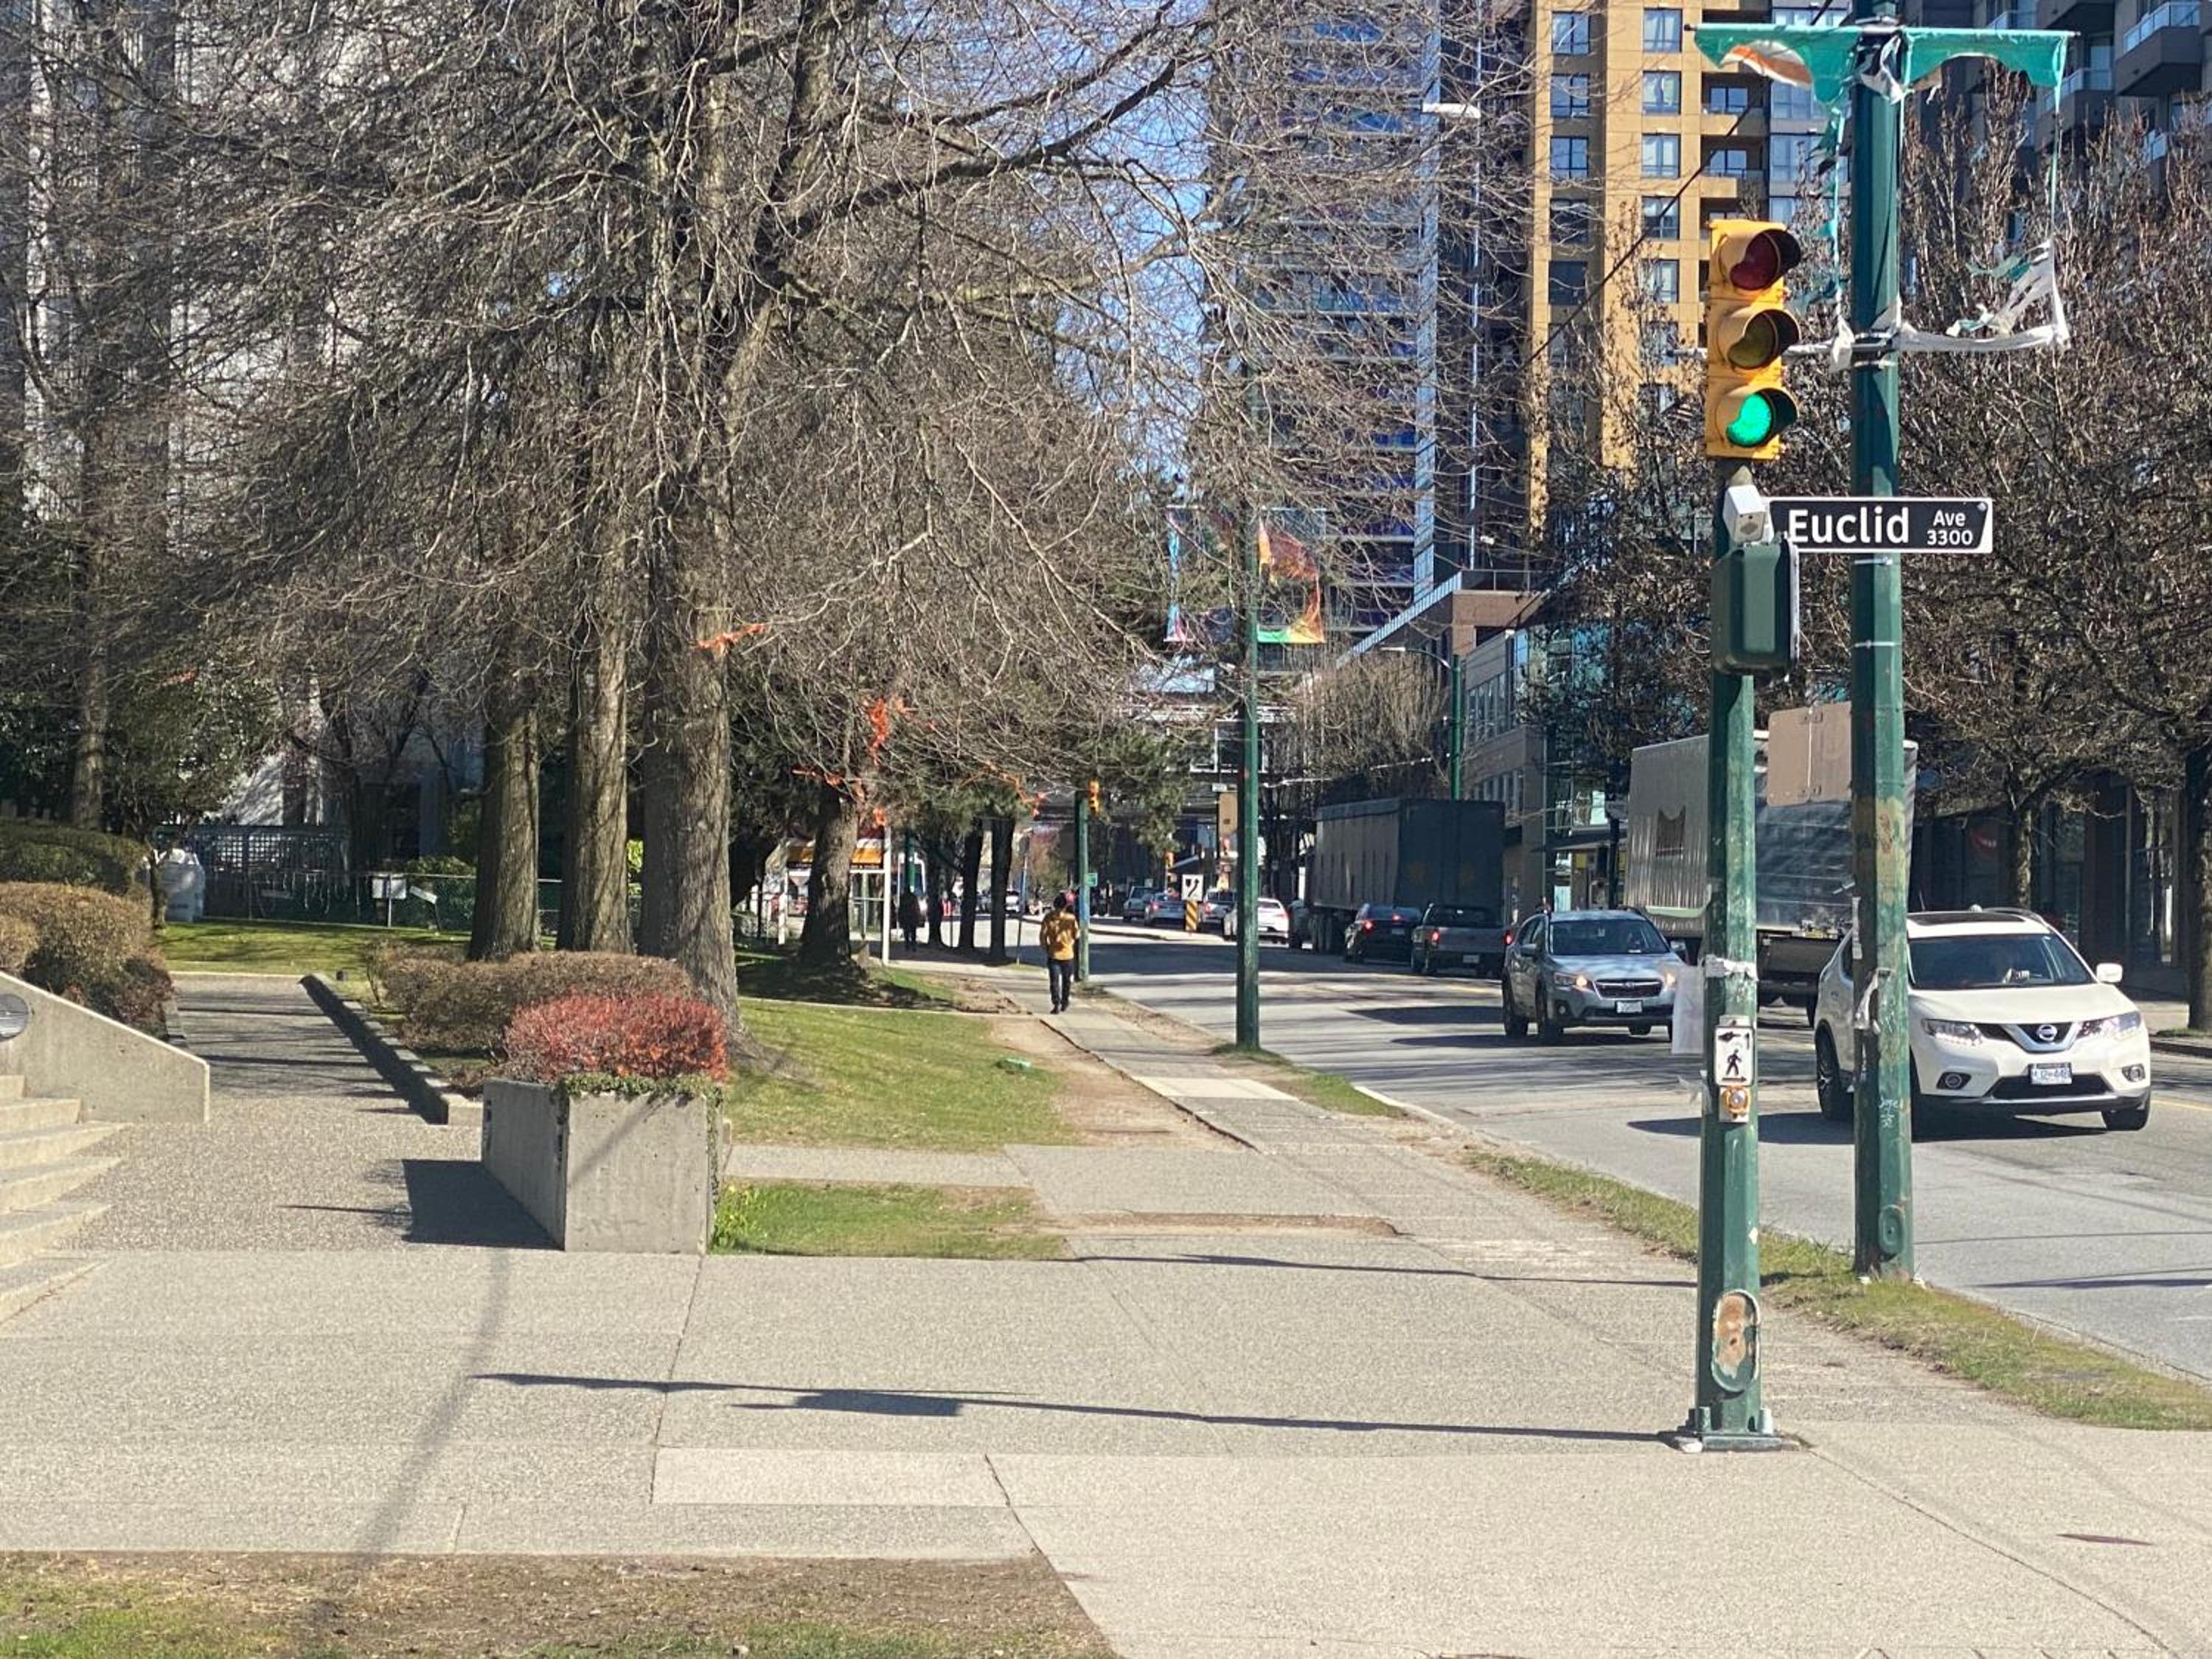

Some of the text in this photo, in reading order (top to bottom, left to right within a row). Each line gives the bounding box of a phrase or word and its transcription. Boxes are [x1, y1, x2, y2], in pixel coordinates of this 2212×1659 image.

[1789, 507, 1966, 543] Euclid Ave
[1927, 529, 1973, 546] 3300
